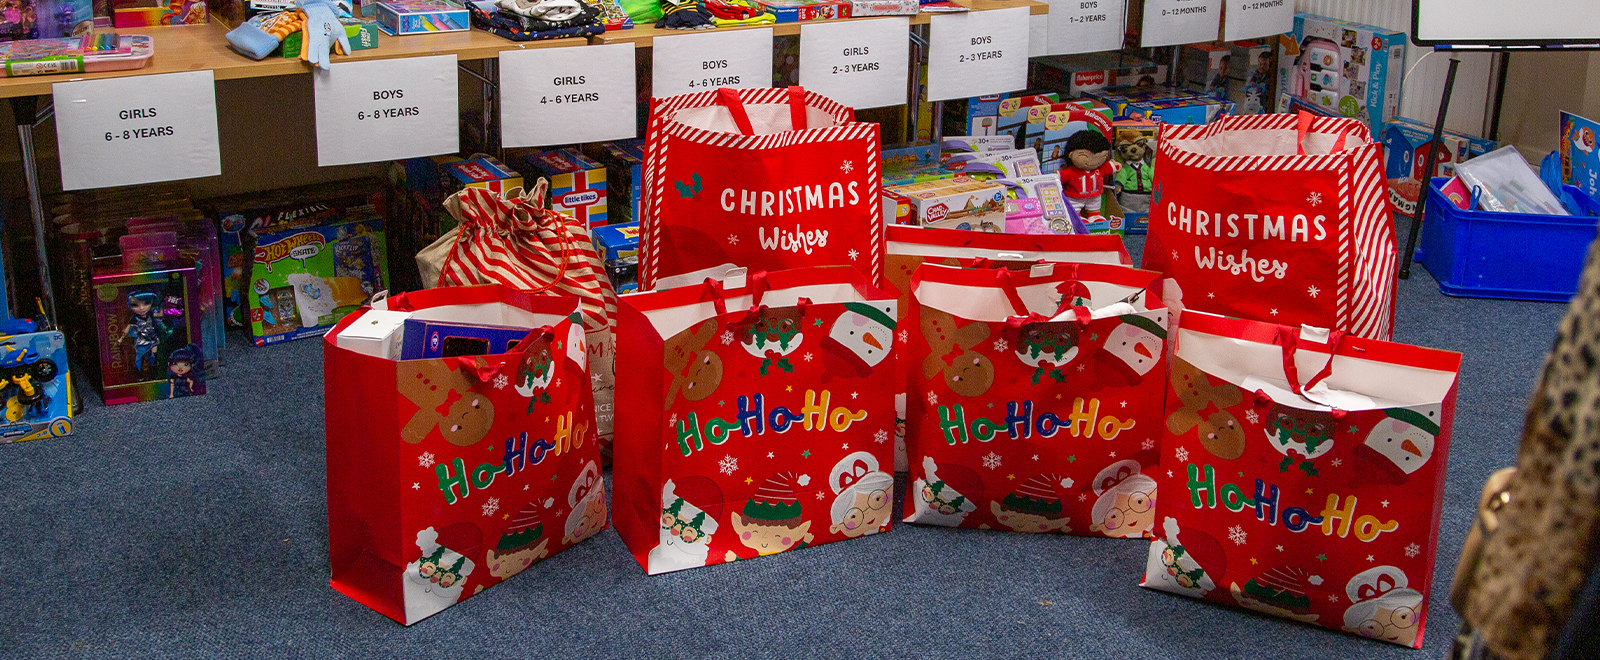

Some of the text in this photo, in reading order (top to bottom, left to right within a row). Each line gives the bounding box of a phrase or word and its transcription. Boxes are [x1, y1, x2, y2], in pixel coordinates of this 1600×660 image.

[1080, 1, 1098, 9] BOYS
[1180, 5, 1207, 15] MONTHS
[1259, 0, 1284, 9] MONTHS
[1085, 14, 1107, 22] YEARS
[971, 36, 992, 46] BOYS
[843, 46, 869, 57] GIRLS
[960, 54, 965, 62] 2
[971, 53, 976, 62] 3
[977, 50, 1003, 61] YEARS
[702, 60, 728, 70] BOYS
[832, 65, 838, 75] 2
[844, 64, 850, 73] 3
[852, 62, 880, 73] YEARS
[1373, 61, 1382, 80] Play
[553, 75, 586, 87] GIRLS
[689, 79, 696, 89] 4
[702, 78, 708, 88] 6
[709, 76, 740, 87] YEARS
[373, 89, 404, 101] BOYS
[540, 95, 548, 105] 4
[555, 94, 563, 105] 6
[564, 92, 600, 104] YEARS
[1370, 90, 1379, 108] Kick
[119, 108, 157, 120] GIRLS
[358, 110, 365, 120] 6
[373, 109, 381, 119] 8
[383, 106, 420, 119] YEARS
[105, 131, 113, 141] 6
[123, 130, 131, 140] 8
[133, 126, 174, 139] YEARS
[1078, 174, 1097, 194] 11
[1588, 168, 1598, 196] Joh
[564, 193, 597, 204] little tikes
[720, 180, 860, 217] CHRISTMAS
[1167, 201, 1327, 242] CHRISTMAS
[758, 223, 829, 255] Wishes
[292, 247, 317, 257] SKATE
[1194, 245, 1288, 283] Wishes
[107, 313, 123, 369] RAINBOW
